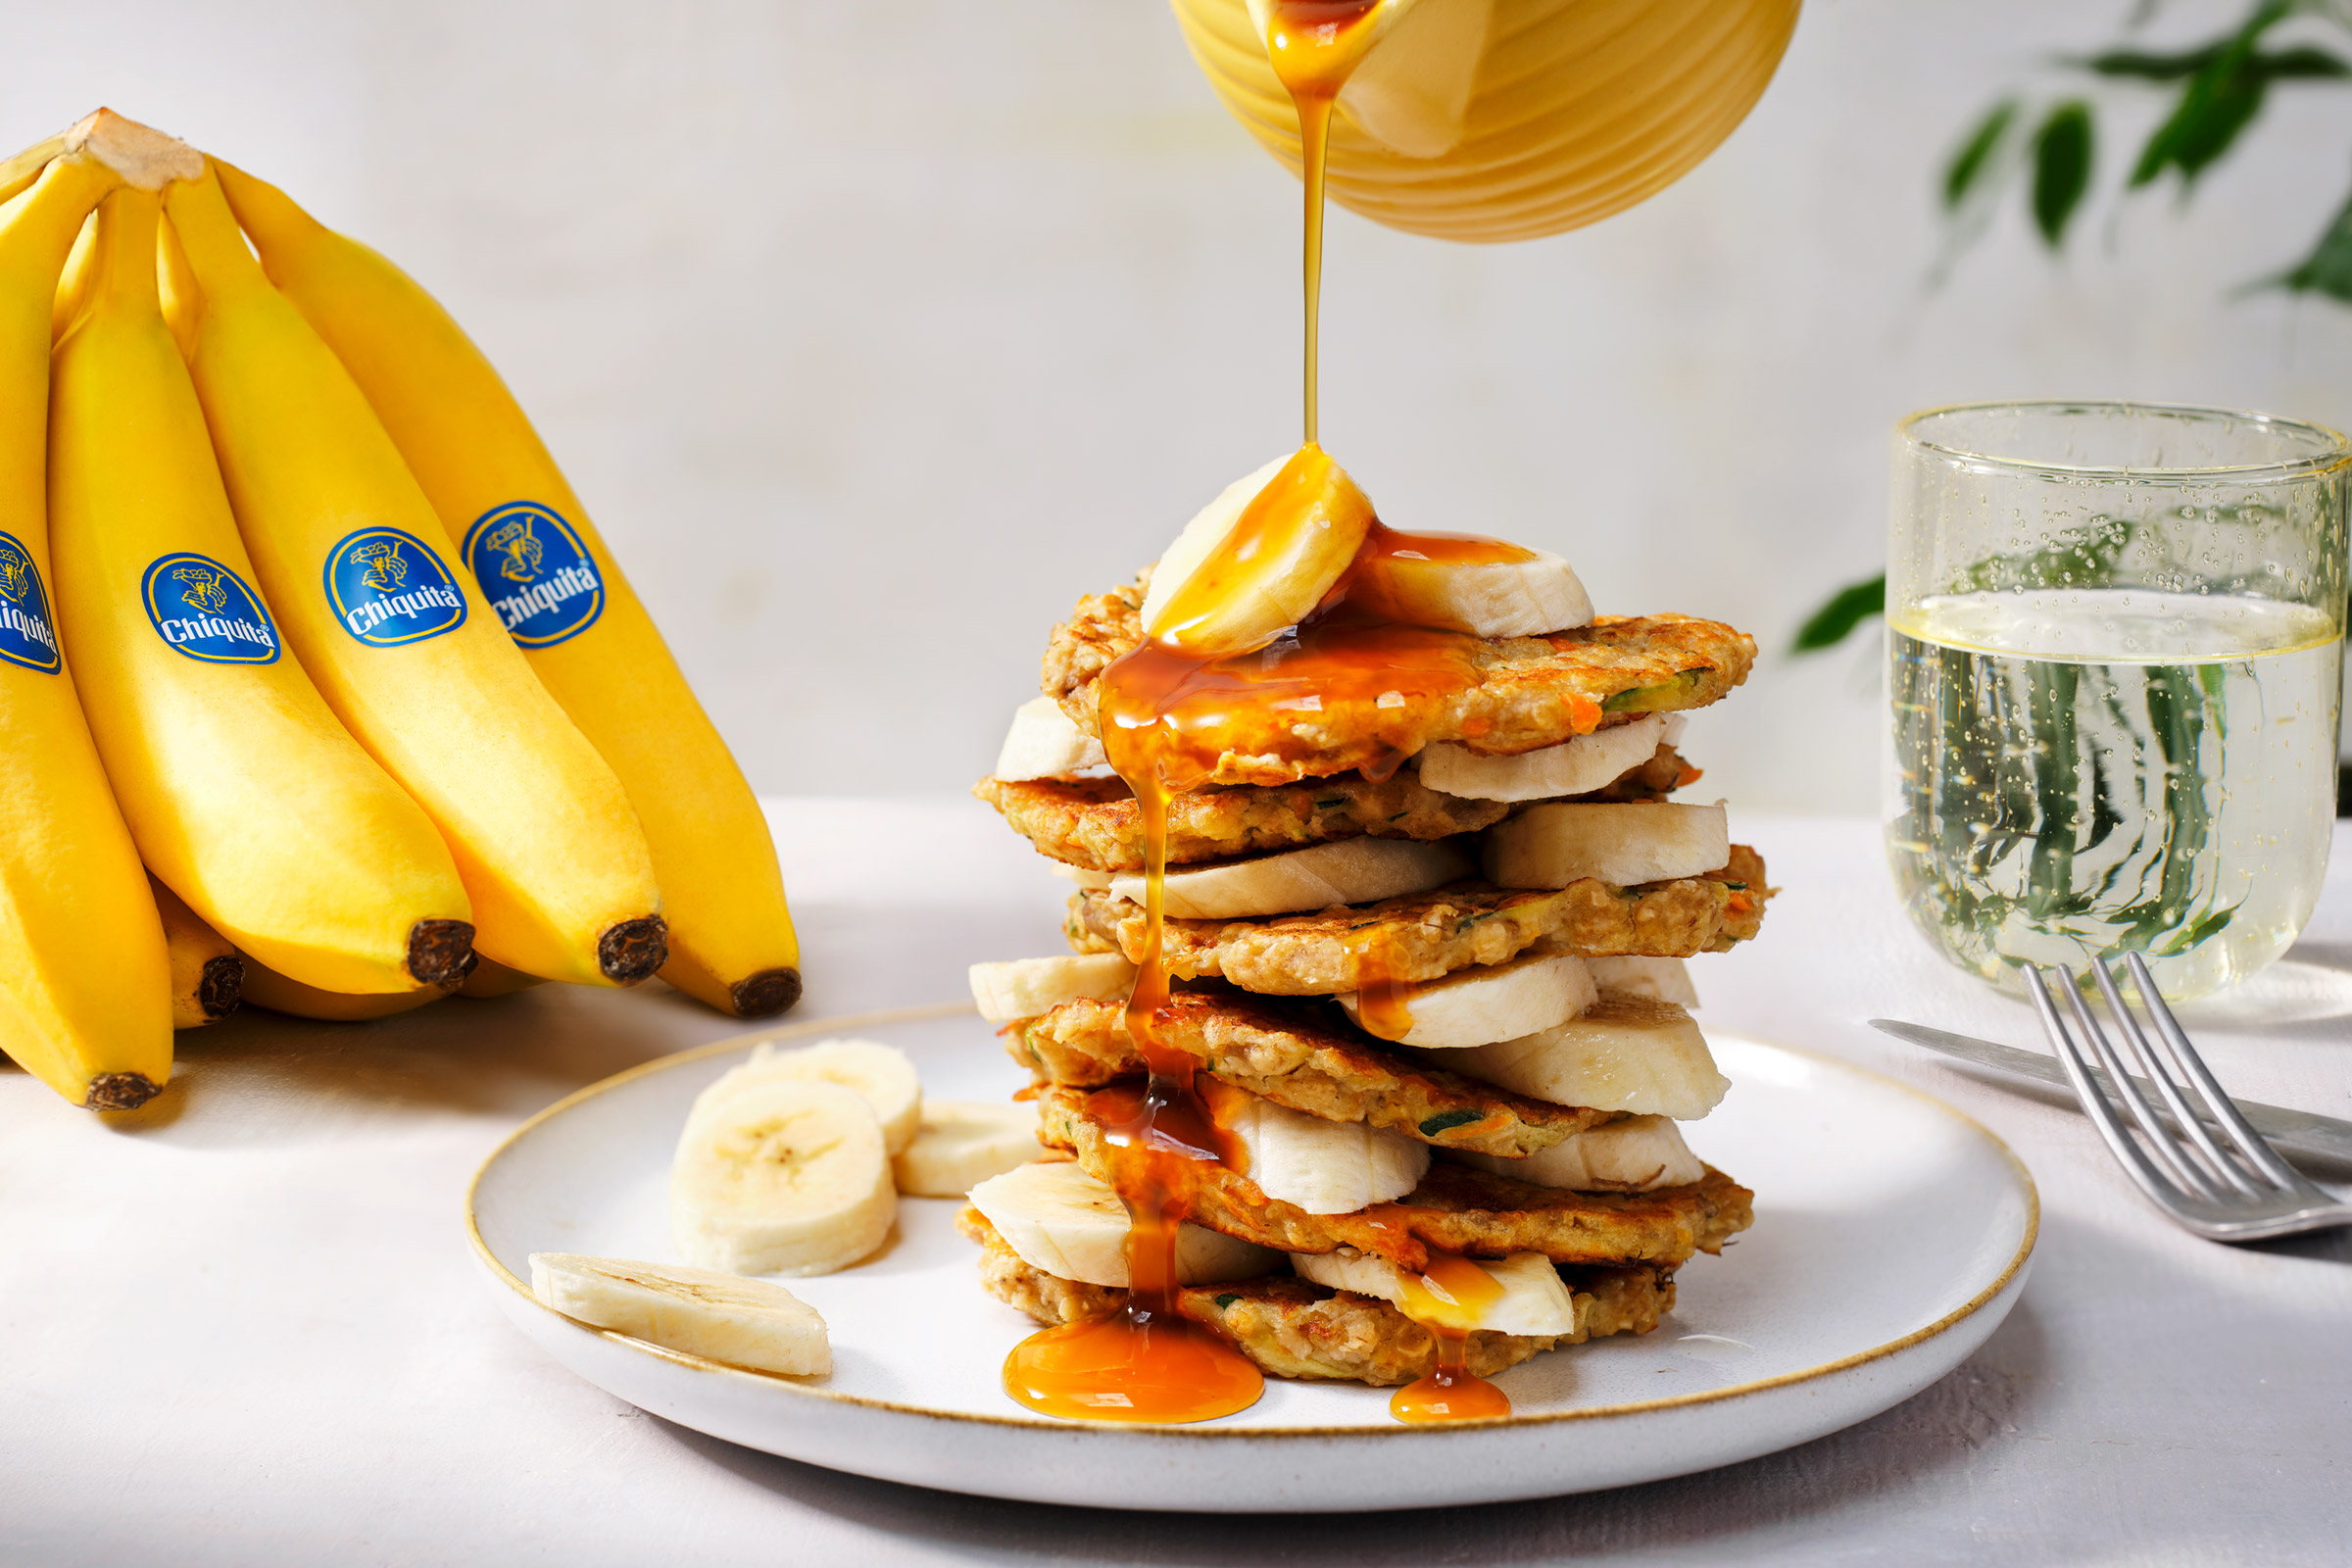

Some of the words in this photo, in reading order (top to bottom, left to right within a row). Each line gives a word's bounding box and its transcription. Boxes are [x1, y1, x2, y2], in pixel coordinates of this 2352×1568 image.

[0, 600, 58, 656] iquita
[160, 612, 275, 648] Chiquita
[346, 585, 462, 635] Chiquita
